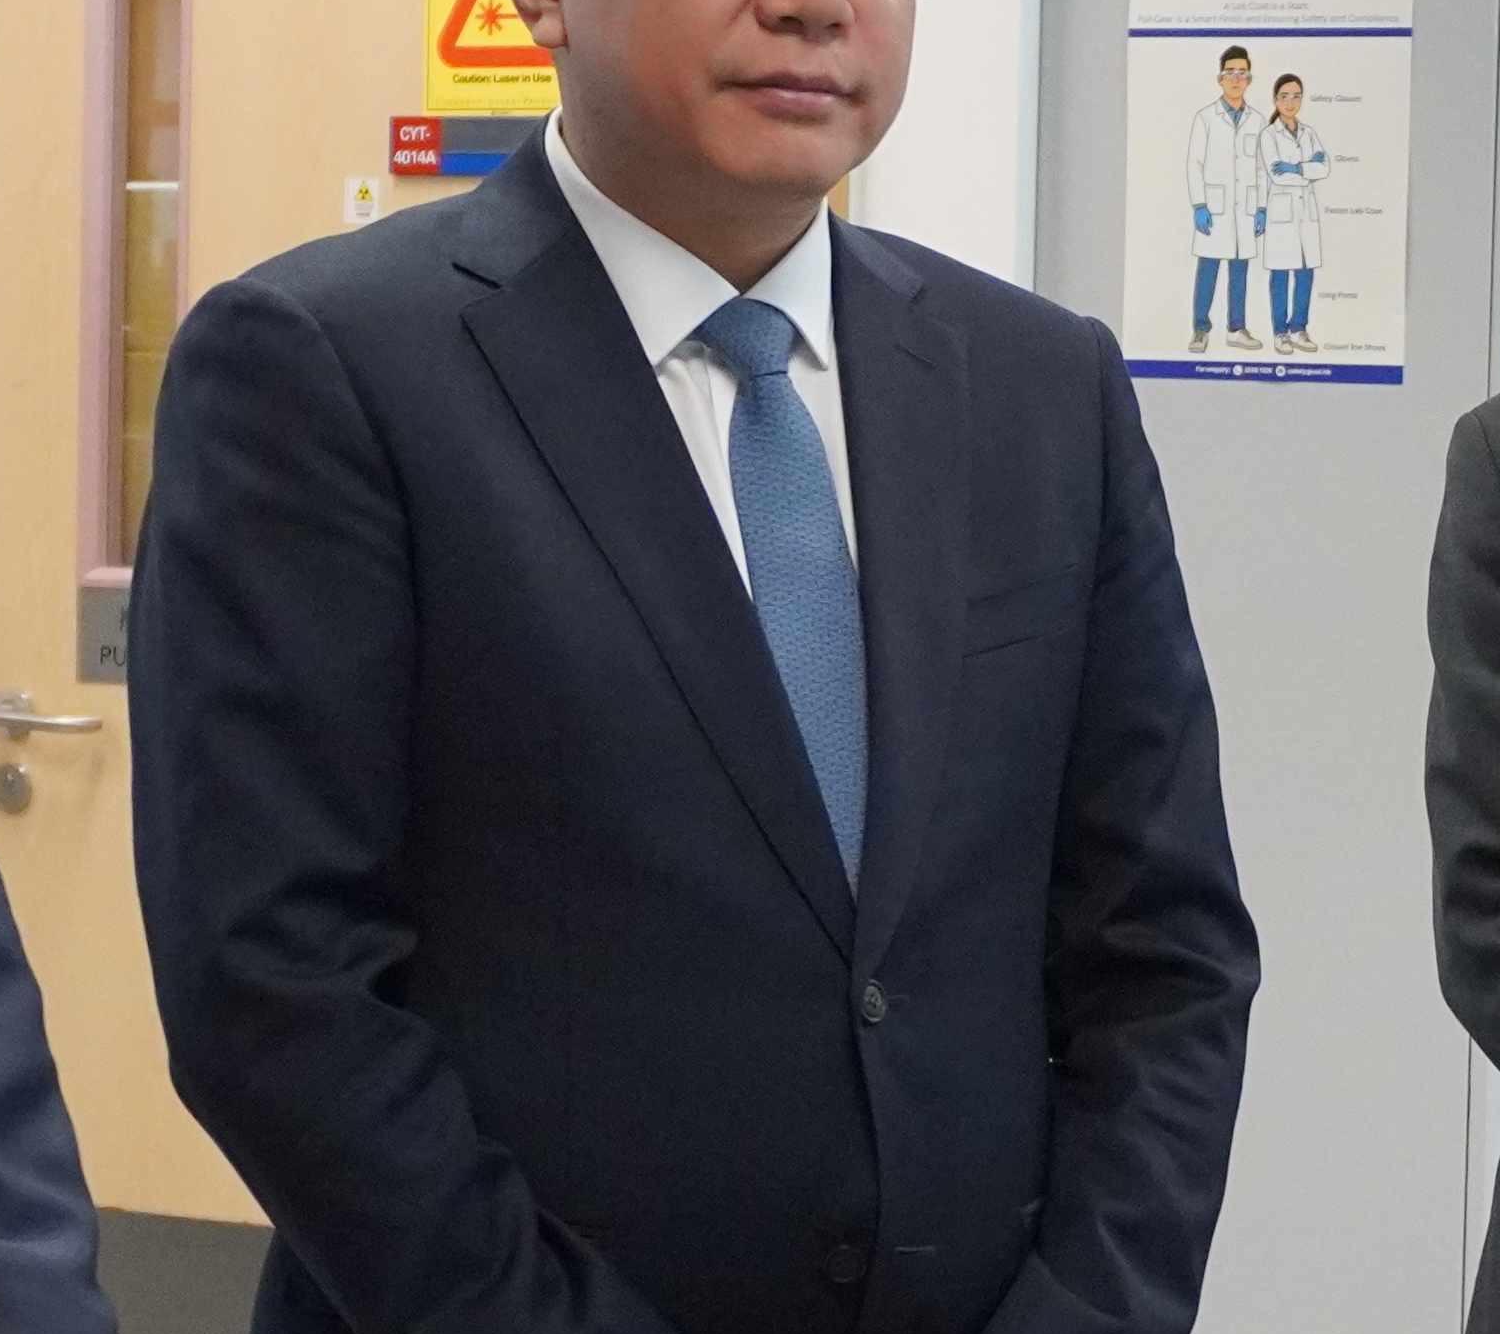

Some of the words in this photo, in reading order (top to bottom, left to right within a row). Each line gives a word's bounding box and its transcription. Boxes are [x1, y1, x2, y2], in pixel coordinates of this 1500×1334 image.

[452, 73, 492, 84] Caution:
[494, 73, 520, 83] Laser
[522, 73, 531, 83] in
[533, 73, 552, 83] Use
[399, 125, 432, 142] CYT-
[393, 150, 437, 165] 4014A
